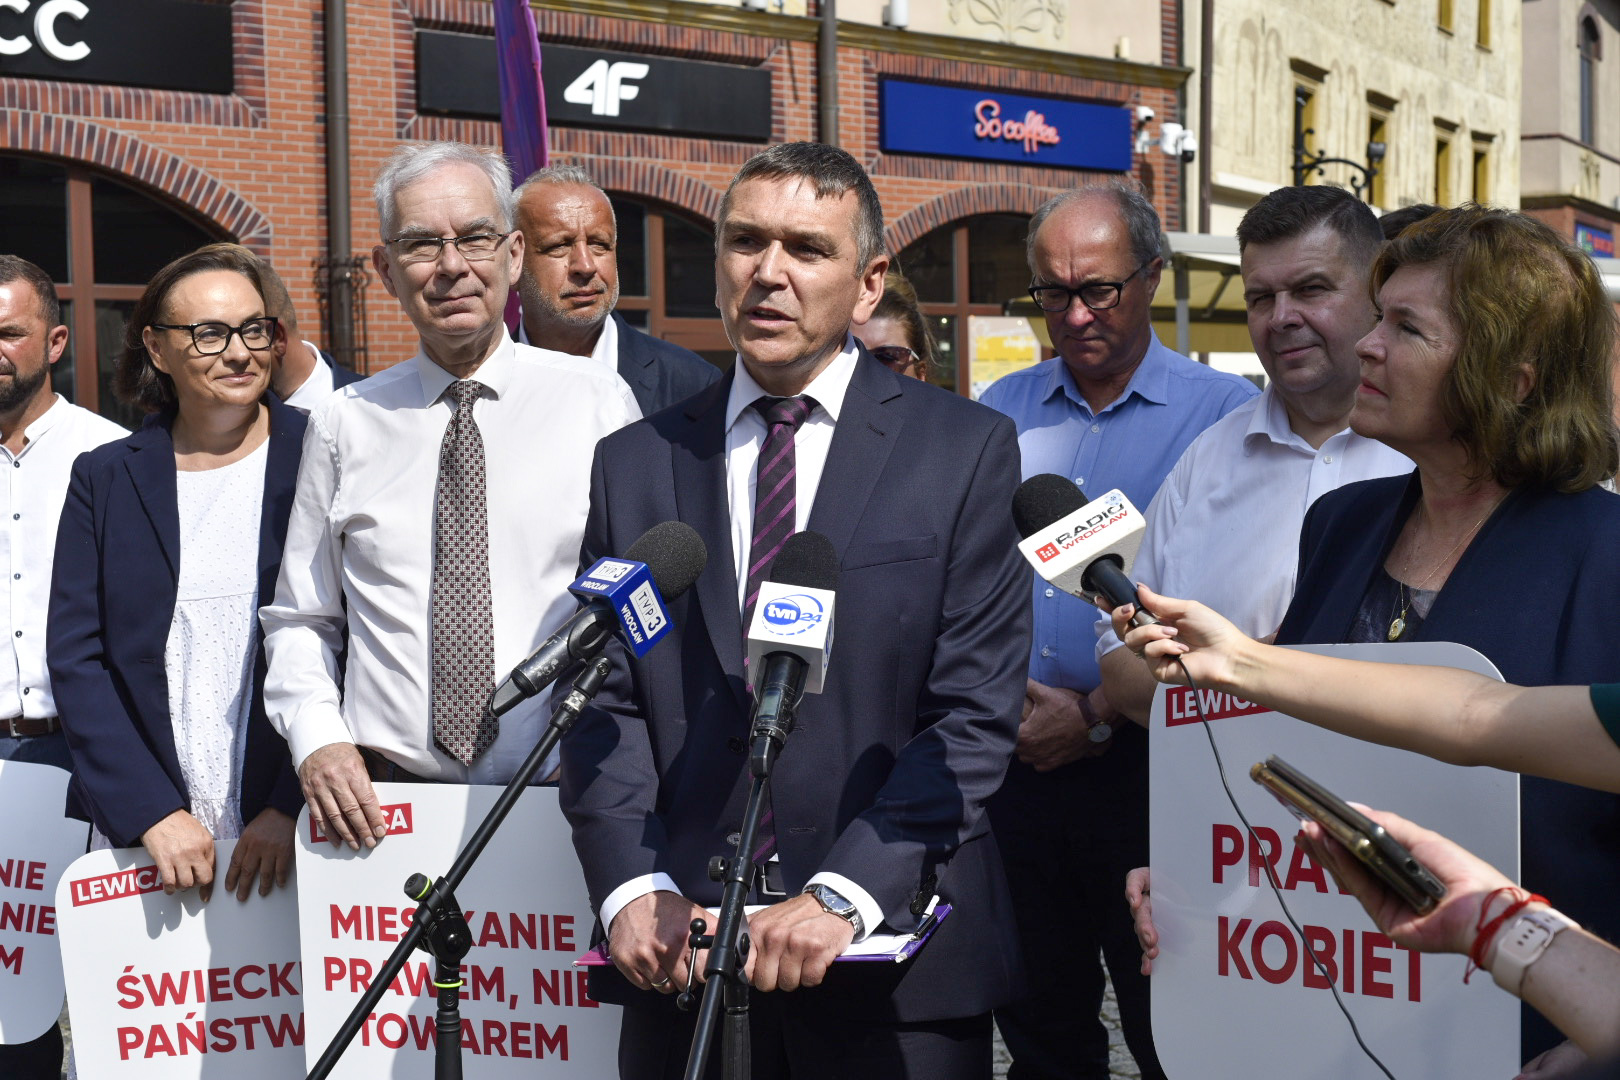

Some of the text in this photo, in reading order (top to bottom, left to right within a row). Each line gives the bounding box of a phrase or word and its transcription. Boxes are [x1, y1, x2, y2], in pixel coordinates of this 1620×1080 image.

[564, 59, 650, 117] 4F
[974, 99, 1060, 153] So coffee
[1055, 503, 1125, 545] RADIO
[1172, 688, 1258, 720] LEWI
[1212, 824, 1352, 895] PRA
[330, 904, 576, 952] MIESANIE
[1218, 916, 1421, 1002] KOBIET
[116, 961, 303, 1009] ŚWIECK
[533, 968, 600, 1008] NIE
[117, 1012, 304, 1060] PAŃSTW
[361, 1012, 569, 1061] TOWAREM
